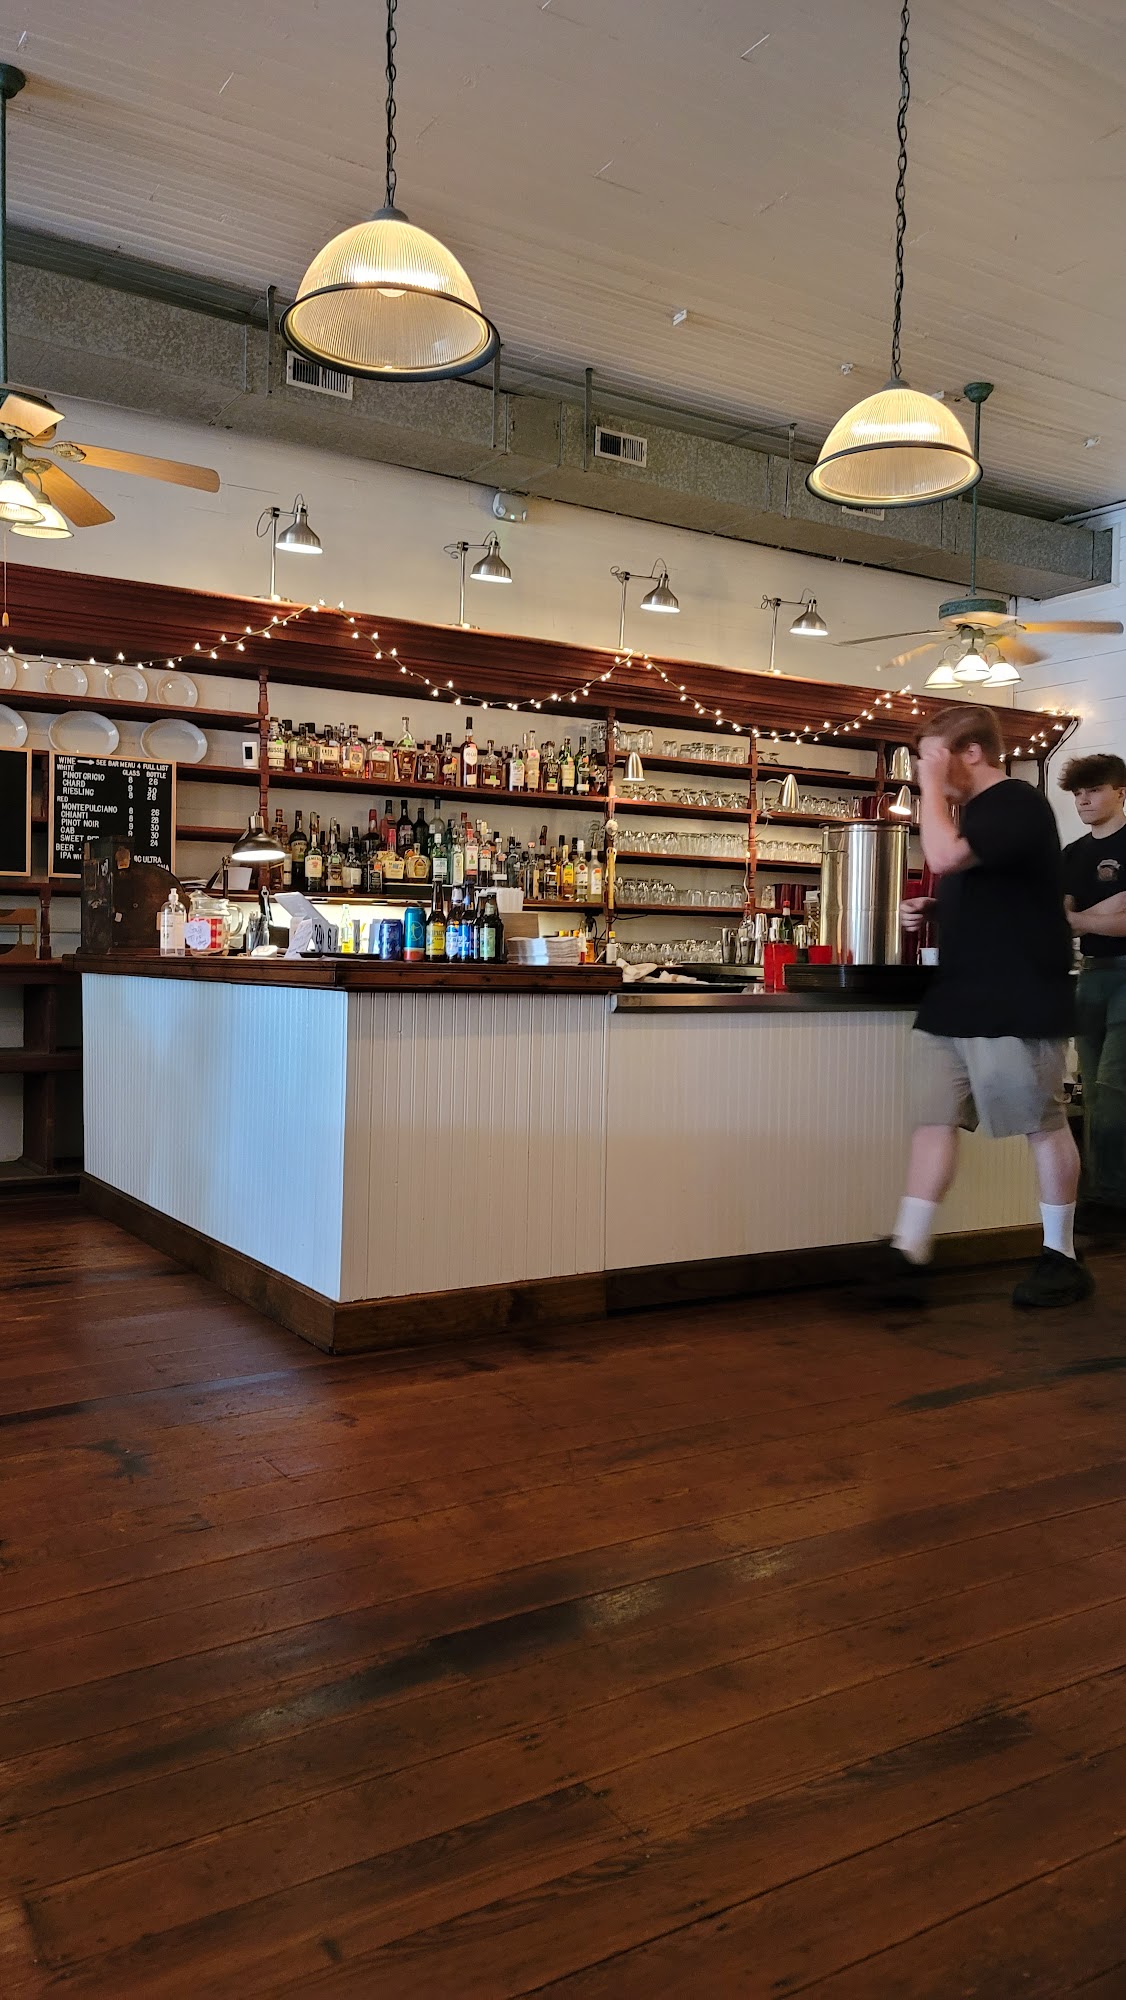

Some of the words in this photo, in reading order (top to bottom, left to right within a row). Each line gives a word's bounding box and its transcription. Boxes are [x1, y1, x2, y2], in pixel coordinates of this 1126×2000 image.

[59, 756, 76, 765] WINE
[62, 771, 82, 779] PINOT
[82, 772, 105, 781] GRIGIO
[146, 771, 166, 779] BOTTLE
[62, 779, 86, 788] CHARD
[62, 787, 94, 796] RIESLING
[62, 802, 118, 814] MONTEPULCIANO
[60, 810, 88, 819] CHIANTI
[61, 818, 81, 826] PINOT
[84, 820, 100, 828] NOIR
[60, 834, 84, 842] SWEET
[56, 843, 74, 851] BEER
[60, 852, 72, 860] IPA
